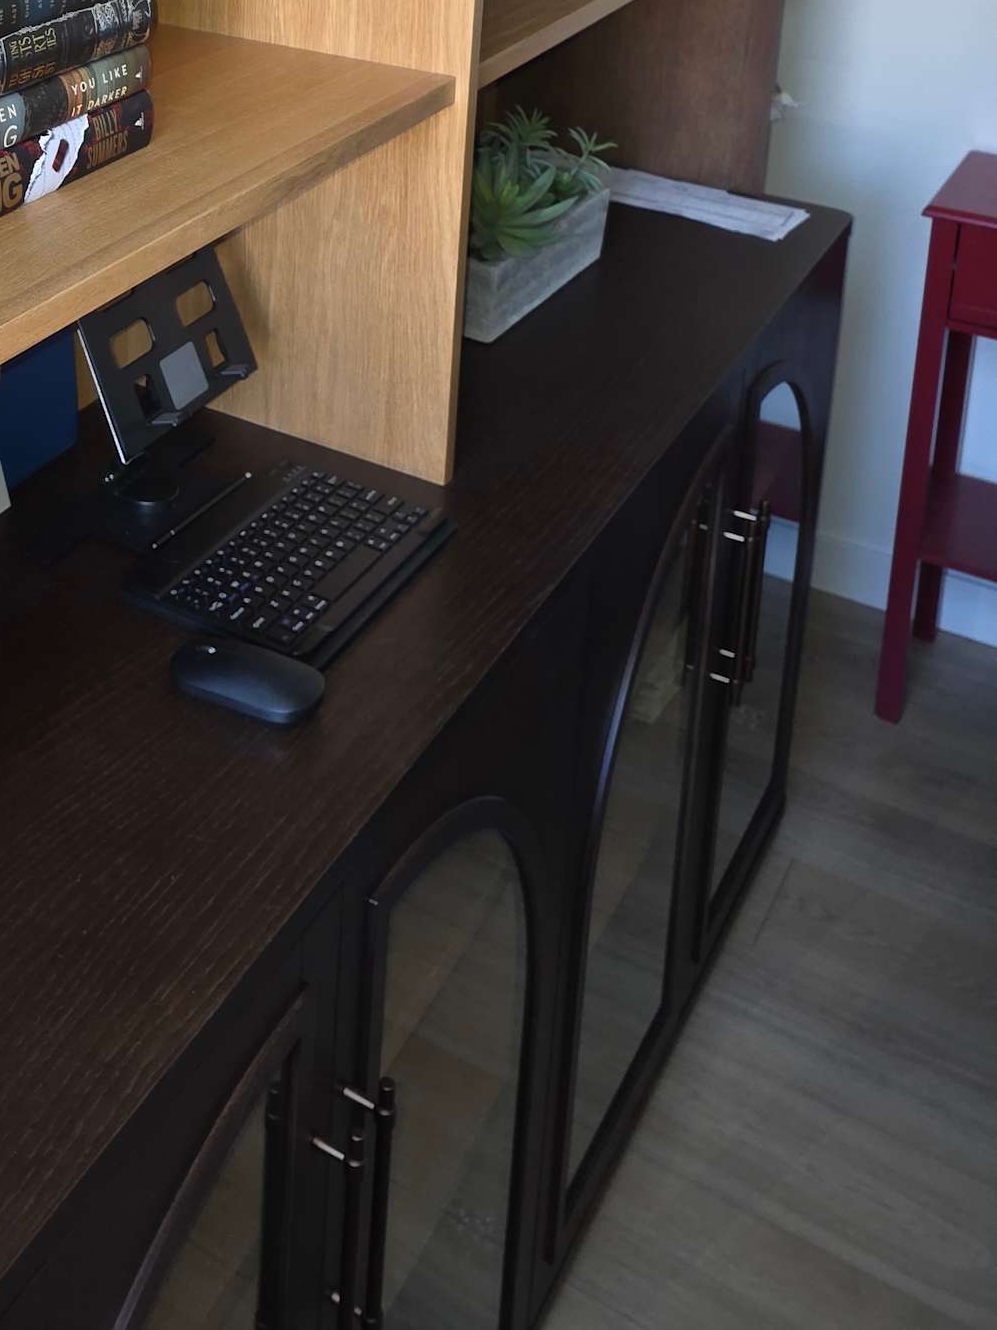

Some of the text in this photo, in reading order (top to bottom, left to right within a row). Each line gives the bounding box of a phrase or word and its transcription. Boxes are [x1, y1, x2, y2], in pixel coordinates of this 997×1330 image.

[71, 64, 128, 95] YOU LIKE
[71, 86, 128, 117] IT DARKER
[91, 109, 119, 139] BILLY
[84, 129, 130, 169] SUMMERS
